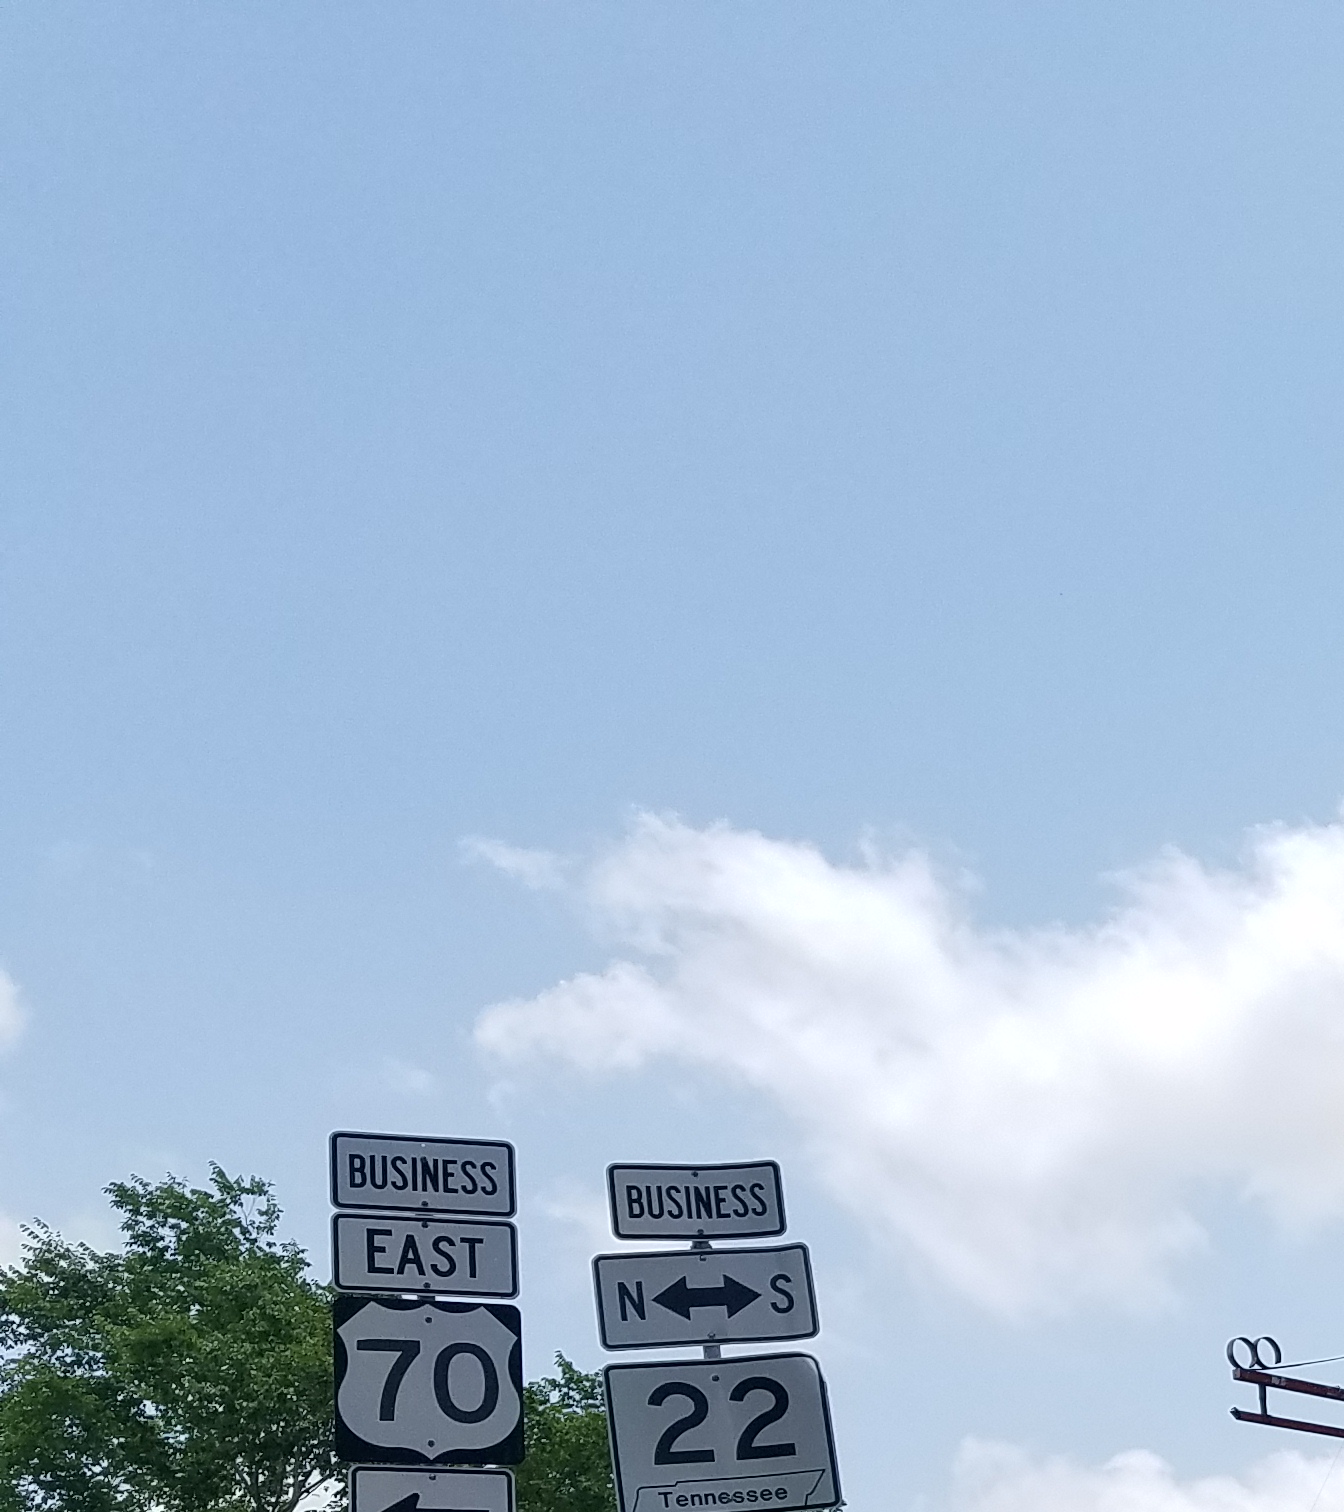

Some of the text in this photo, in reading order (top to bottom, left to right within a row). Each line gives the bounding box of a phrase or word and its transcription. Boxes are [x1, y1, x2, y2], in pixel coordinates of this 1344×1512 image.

[348, 1153, 498, 1196] BUSINESS
[625, 1183, 768, 1219] BUSINESS
[366, 1229, 484, 1279] EAST
[617, 1274, 795, 1321] N S
[356, 1338, 500, 1424] 70
[647, 1376, 797, 1466] 22
[658, 1485, 789, 1509] Tennessee
